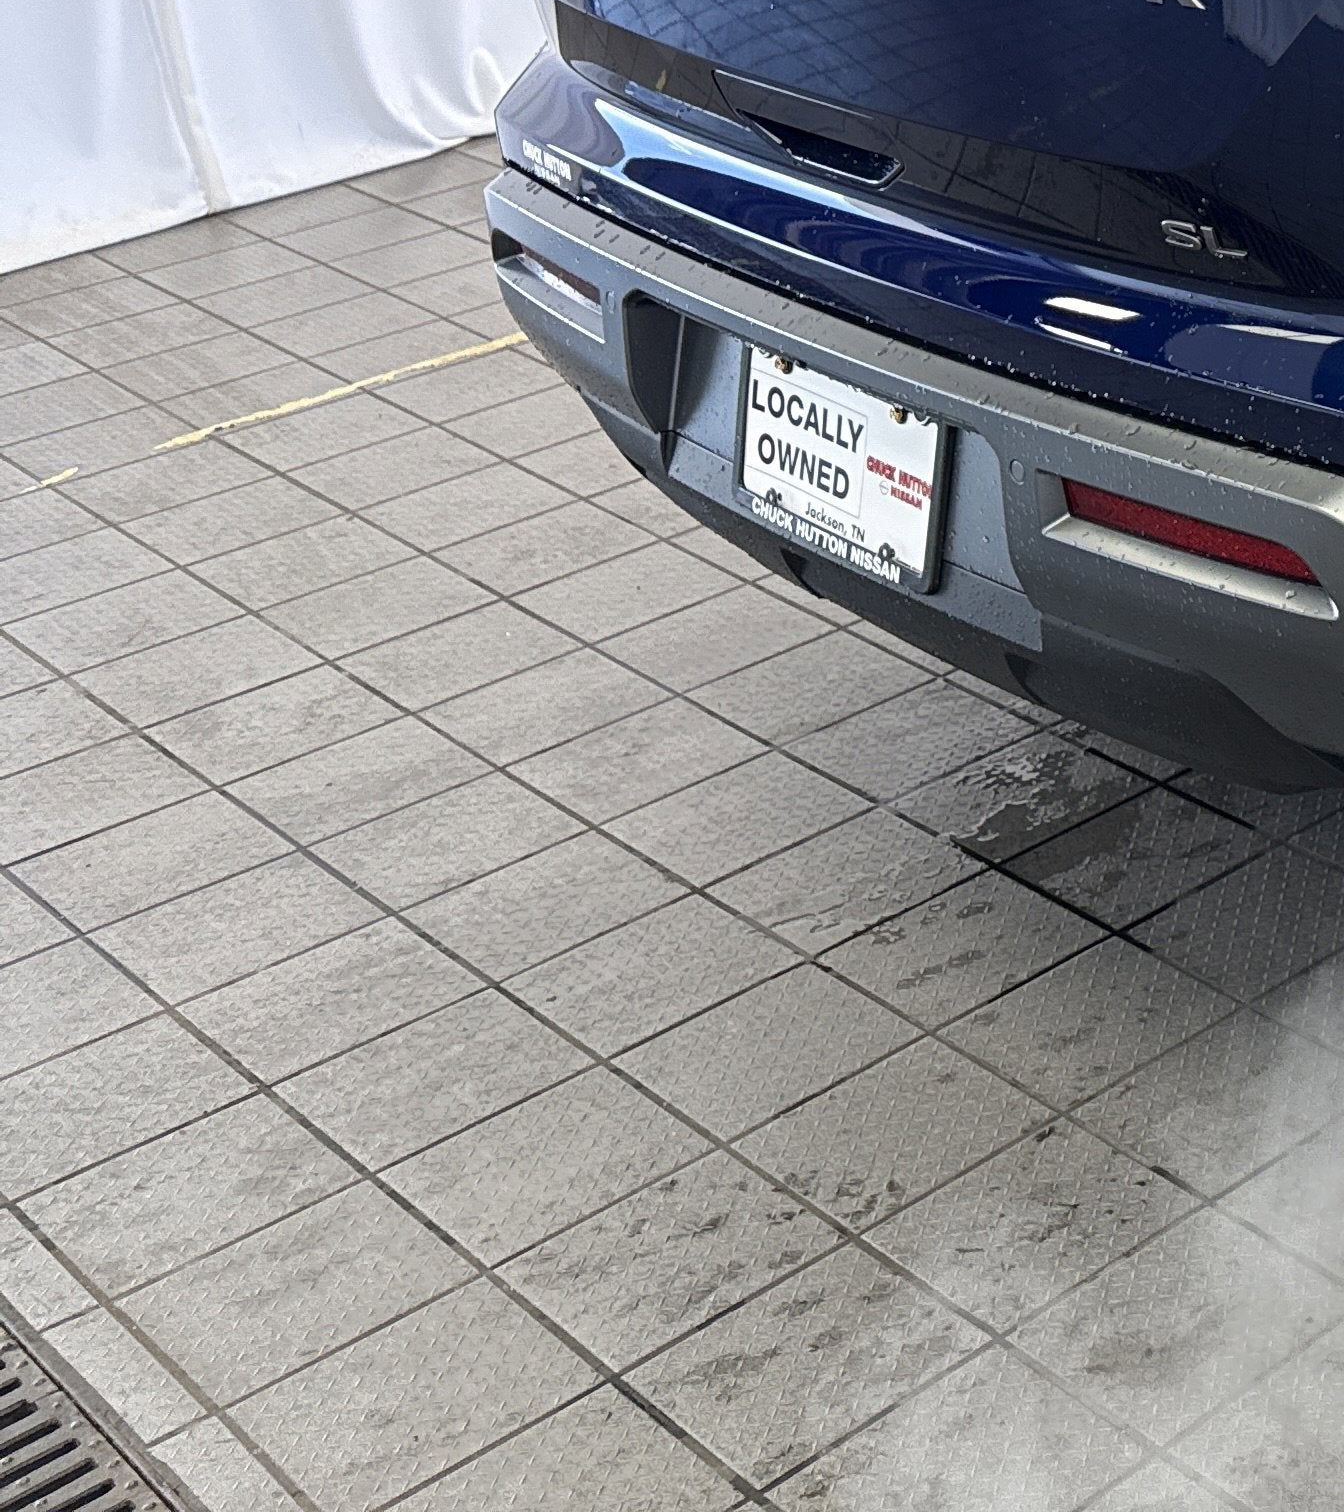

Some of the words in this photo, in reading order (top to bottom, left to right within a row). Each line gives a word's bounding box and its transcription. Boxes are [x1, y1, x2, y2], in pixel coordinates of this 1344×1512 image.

[1161, 219, 1248, 257] SL
[752, 379, 864, 453] LOCALLY
[757, 433, 849, 499] OWNED
[805, 502, 848, 534] Jackson,
[851, 523, 866, 542] TN
[891, 485, 922, 510] NISSAN
[751, 497, 794, 533] CHUCK
[796, 518, 848, 558] HUTTON
[849, 544, 900, 583] NISSAN
